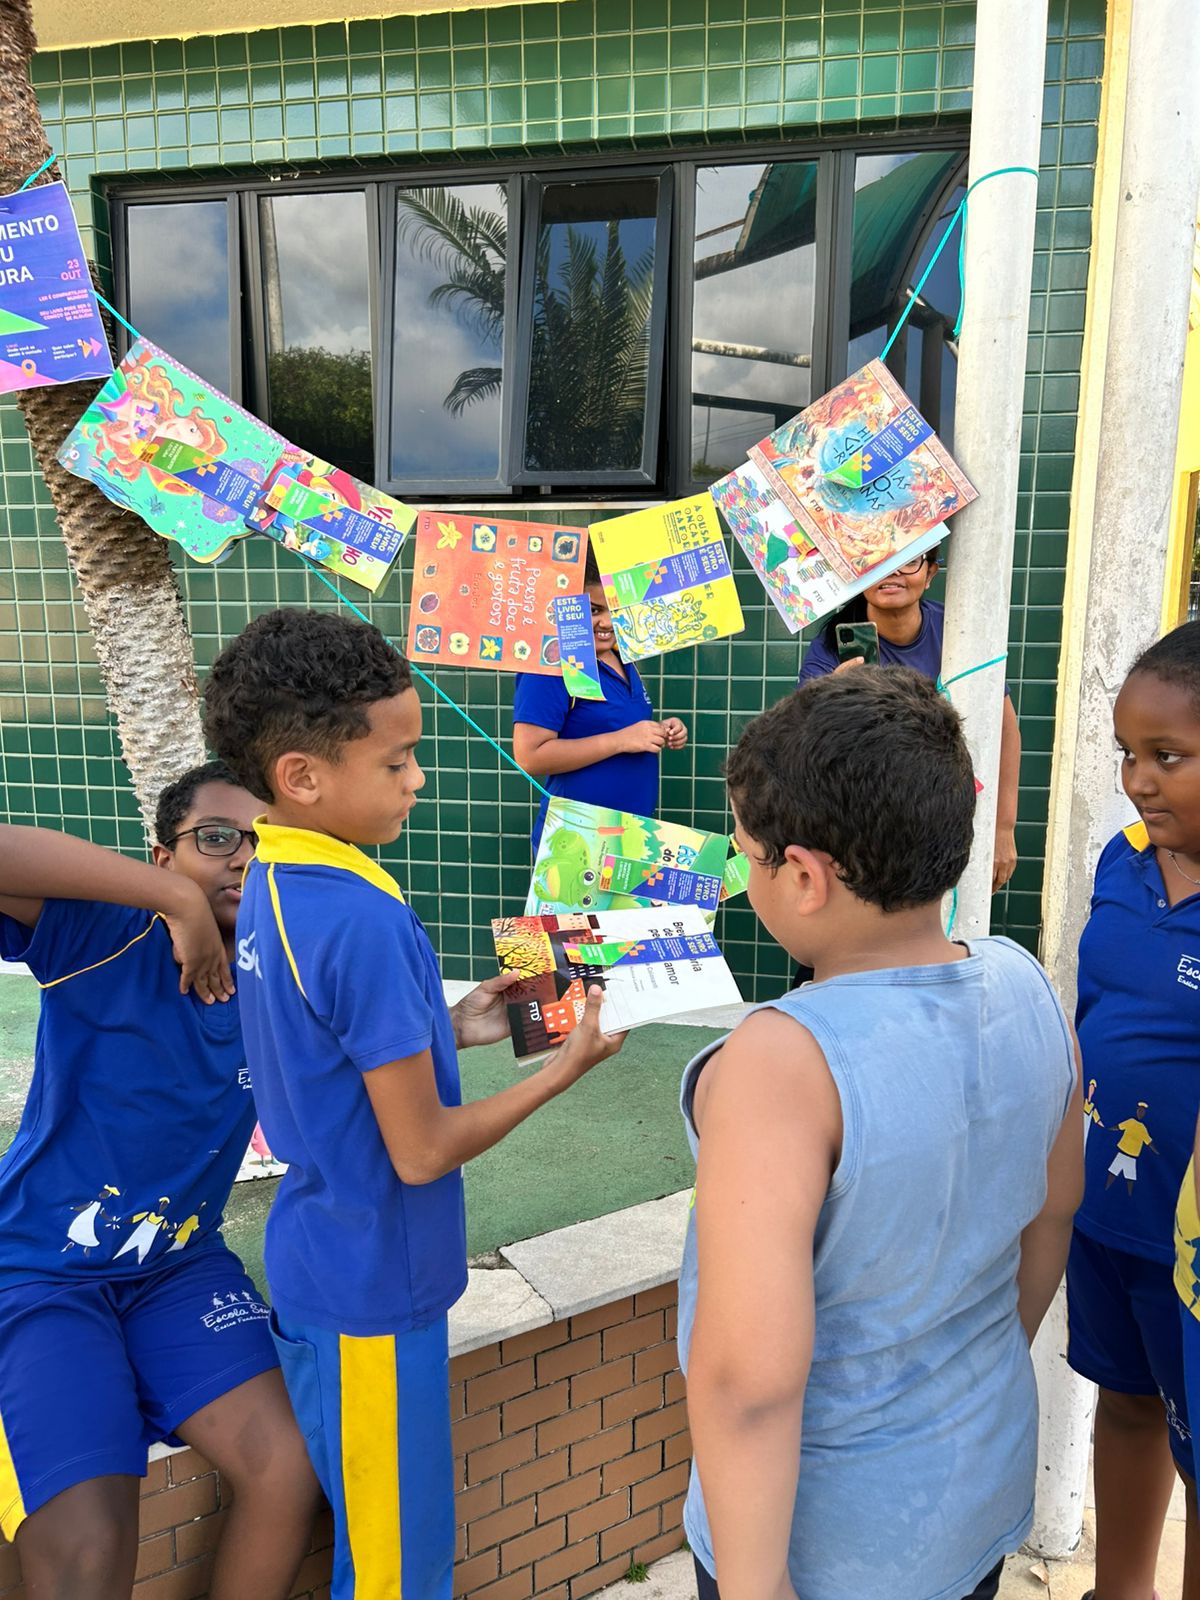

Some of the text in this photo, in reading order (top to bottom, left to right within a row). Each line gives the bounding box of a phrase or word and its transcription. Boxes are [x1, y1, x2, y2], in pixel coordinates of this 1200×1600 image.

[67, 259, 80, 269] 23
[61, 271, 81, 281] OUT
[900, 415, 919, 436] LIVRO
[906, 409, 924, 428] ESTE
[378, 529, 394, 552] LIVRO
[387, 532, 400, 552] ESTE
[706, 545, 719, 571] LIVRO
[714, 543, 726, 565] ESTE
[487, 560, 506, 626] e gostosa
[505, 558, 527, 632] fruta doce
[557, 597, 577, 605] ESTE
[558, 604, 582, 613] LIVRO
[565, 612, 585, 621] SEU!
[662, 848, 675, 862] do
[702, 877, 712, 901] LIVRO
[709, 878, 719, 899] ESTE
[672, 921, 686, 937] Brev
[664, 962, 679, 985] amor
[1177, 957, 1200, 980] Esc
[529, 1001, 542, 1021] FTD
[203, 1308, 249, 1328] Escola
